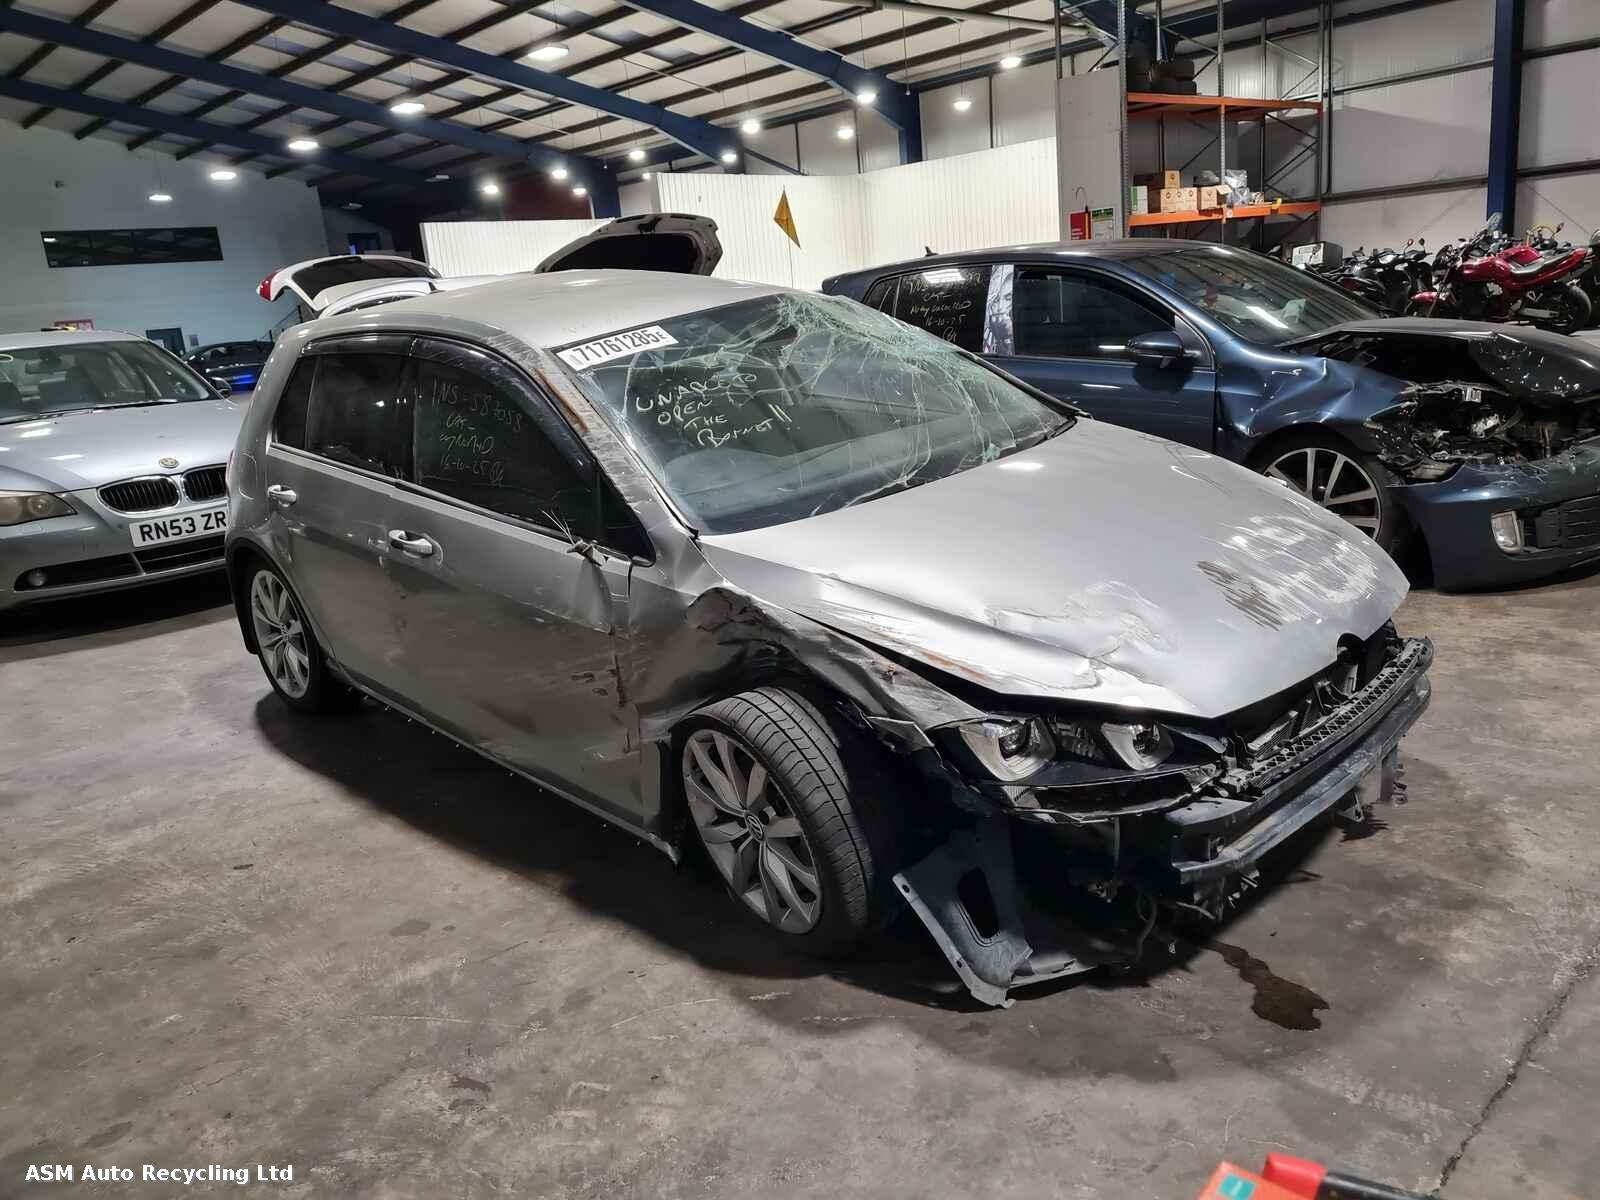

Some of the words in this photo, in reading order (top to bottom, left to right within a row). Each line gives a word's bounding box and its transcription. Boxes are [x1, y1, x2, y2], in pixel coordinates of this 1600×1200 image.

[657, 399, 713, 425] OPEN
[683, 414, 728, 430] THE
[138, 516, 197, 542] RN53
